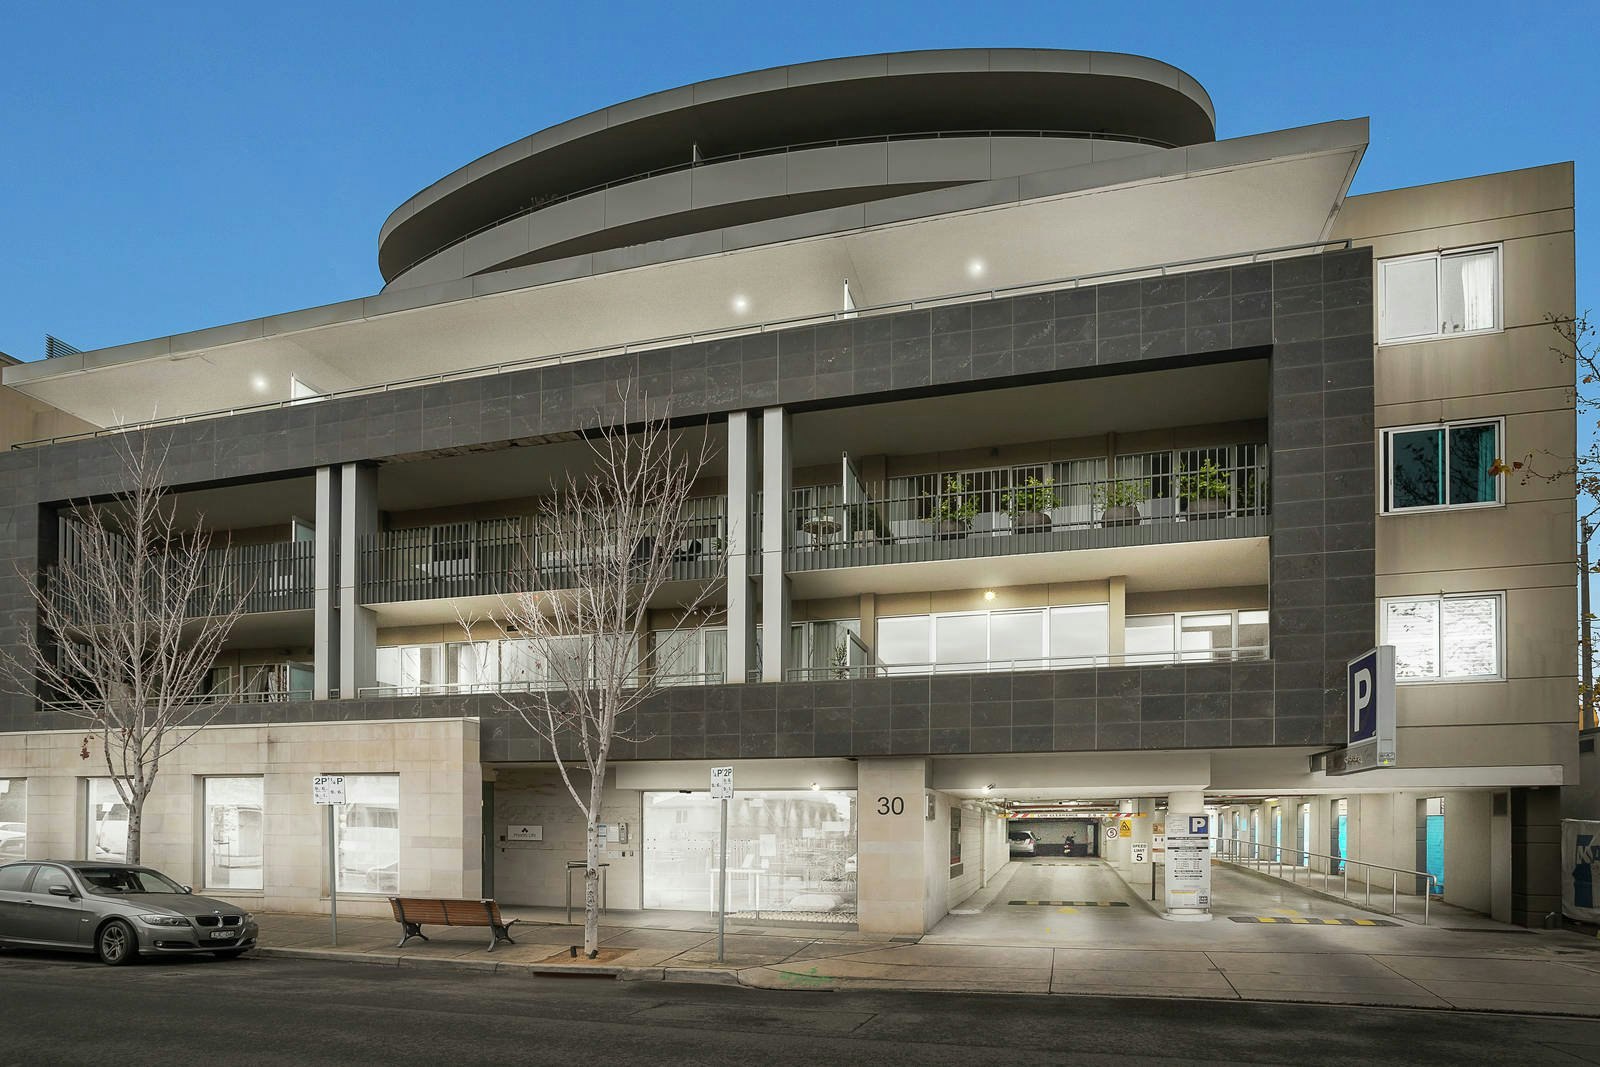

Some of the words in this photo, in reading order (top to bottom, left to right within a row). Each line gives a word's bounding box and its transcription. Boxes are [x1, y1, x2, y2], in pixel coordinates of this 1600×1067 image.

[1354, 667, 1372, 733] P
[723, 768, 732, 776] 2P
[877, 796, 904, 815] 30
[1192, 817, 1206, 832] P
[1136, 853, 1143, 862] 5
